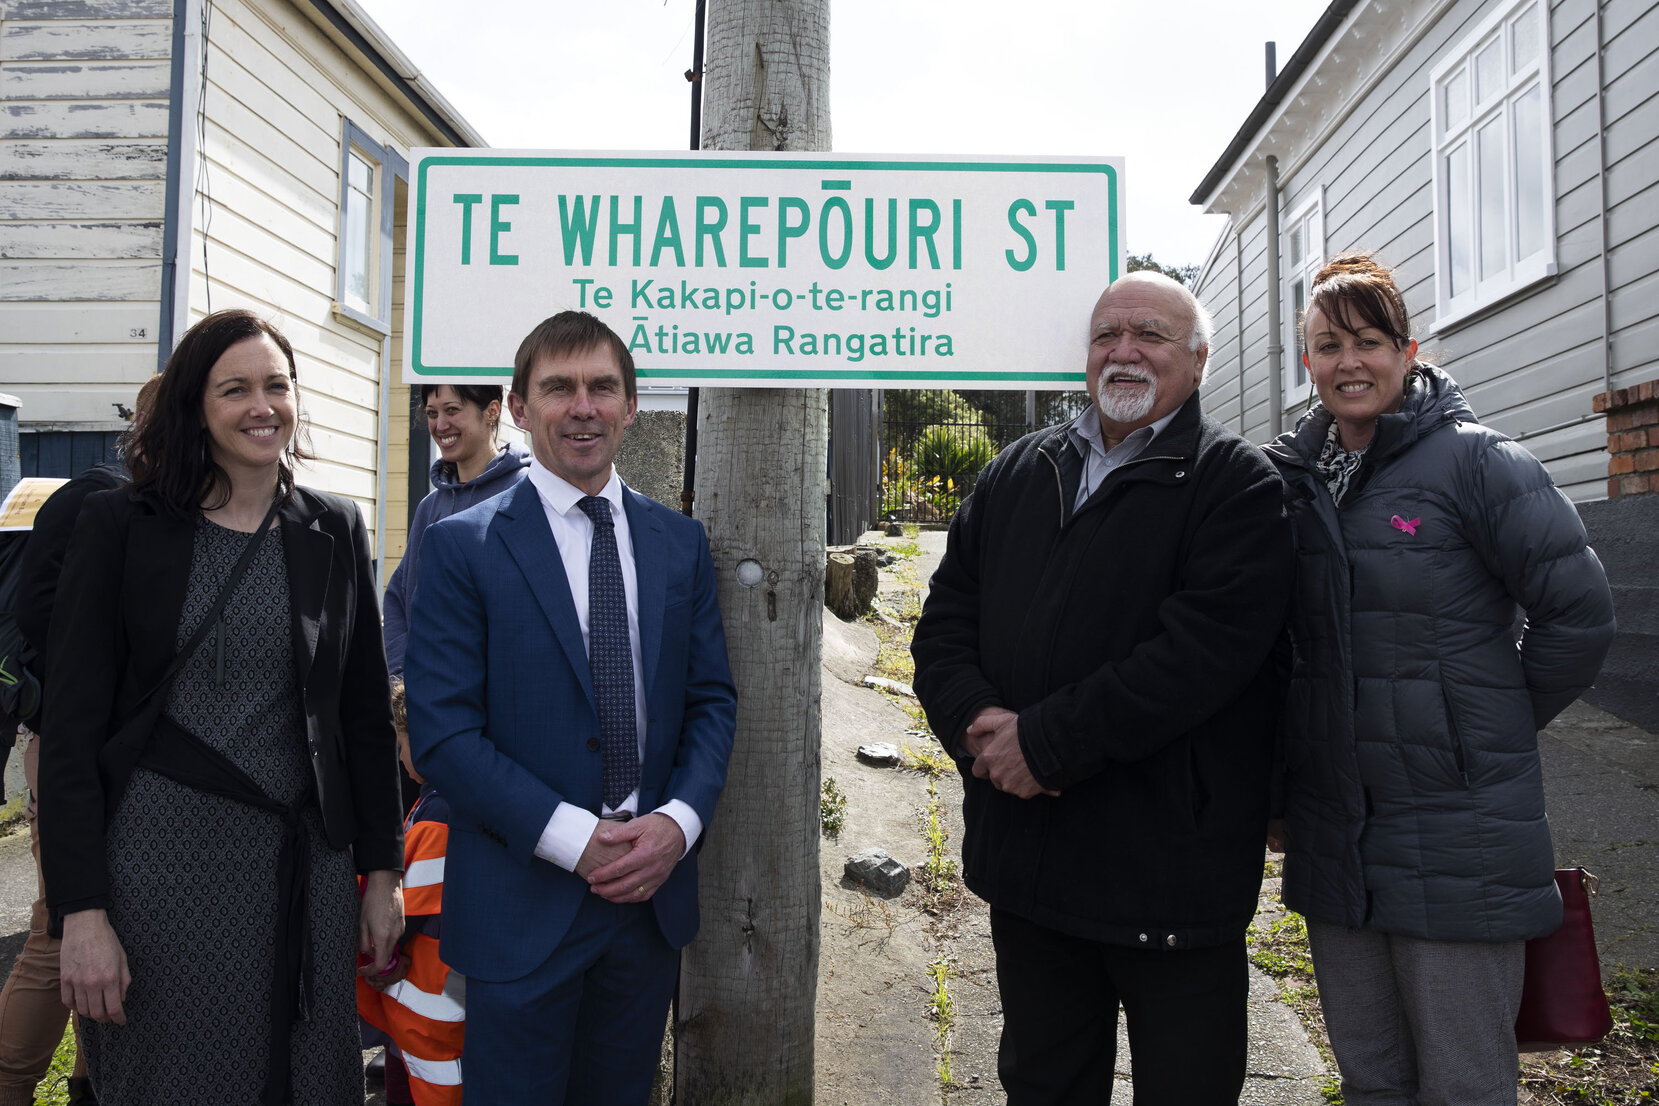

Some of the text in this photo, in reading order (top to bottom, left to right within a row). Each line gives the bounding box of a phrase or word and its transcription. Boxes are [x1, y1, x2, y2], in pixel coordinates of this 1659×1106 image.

[452, 179, 1076, 273] TE WHAREPŌURI ST
[572, 278, 954, 319] Te Kakapi-o-te-rangi
[130, 328, 146, 338] 34
[628, 315, 955, 363] Ātiawa Rangatira
